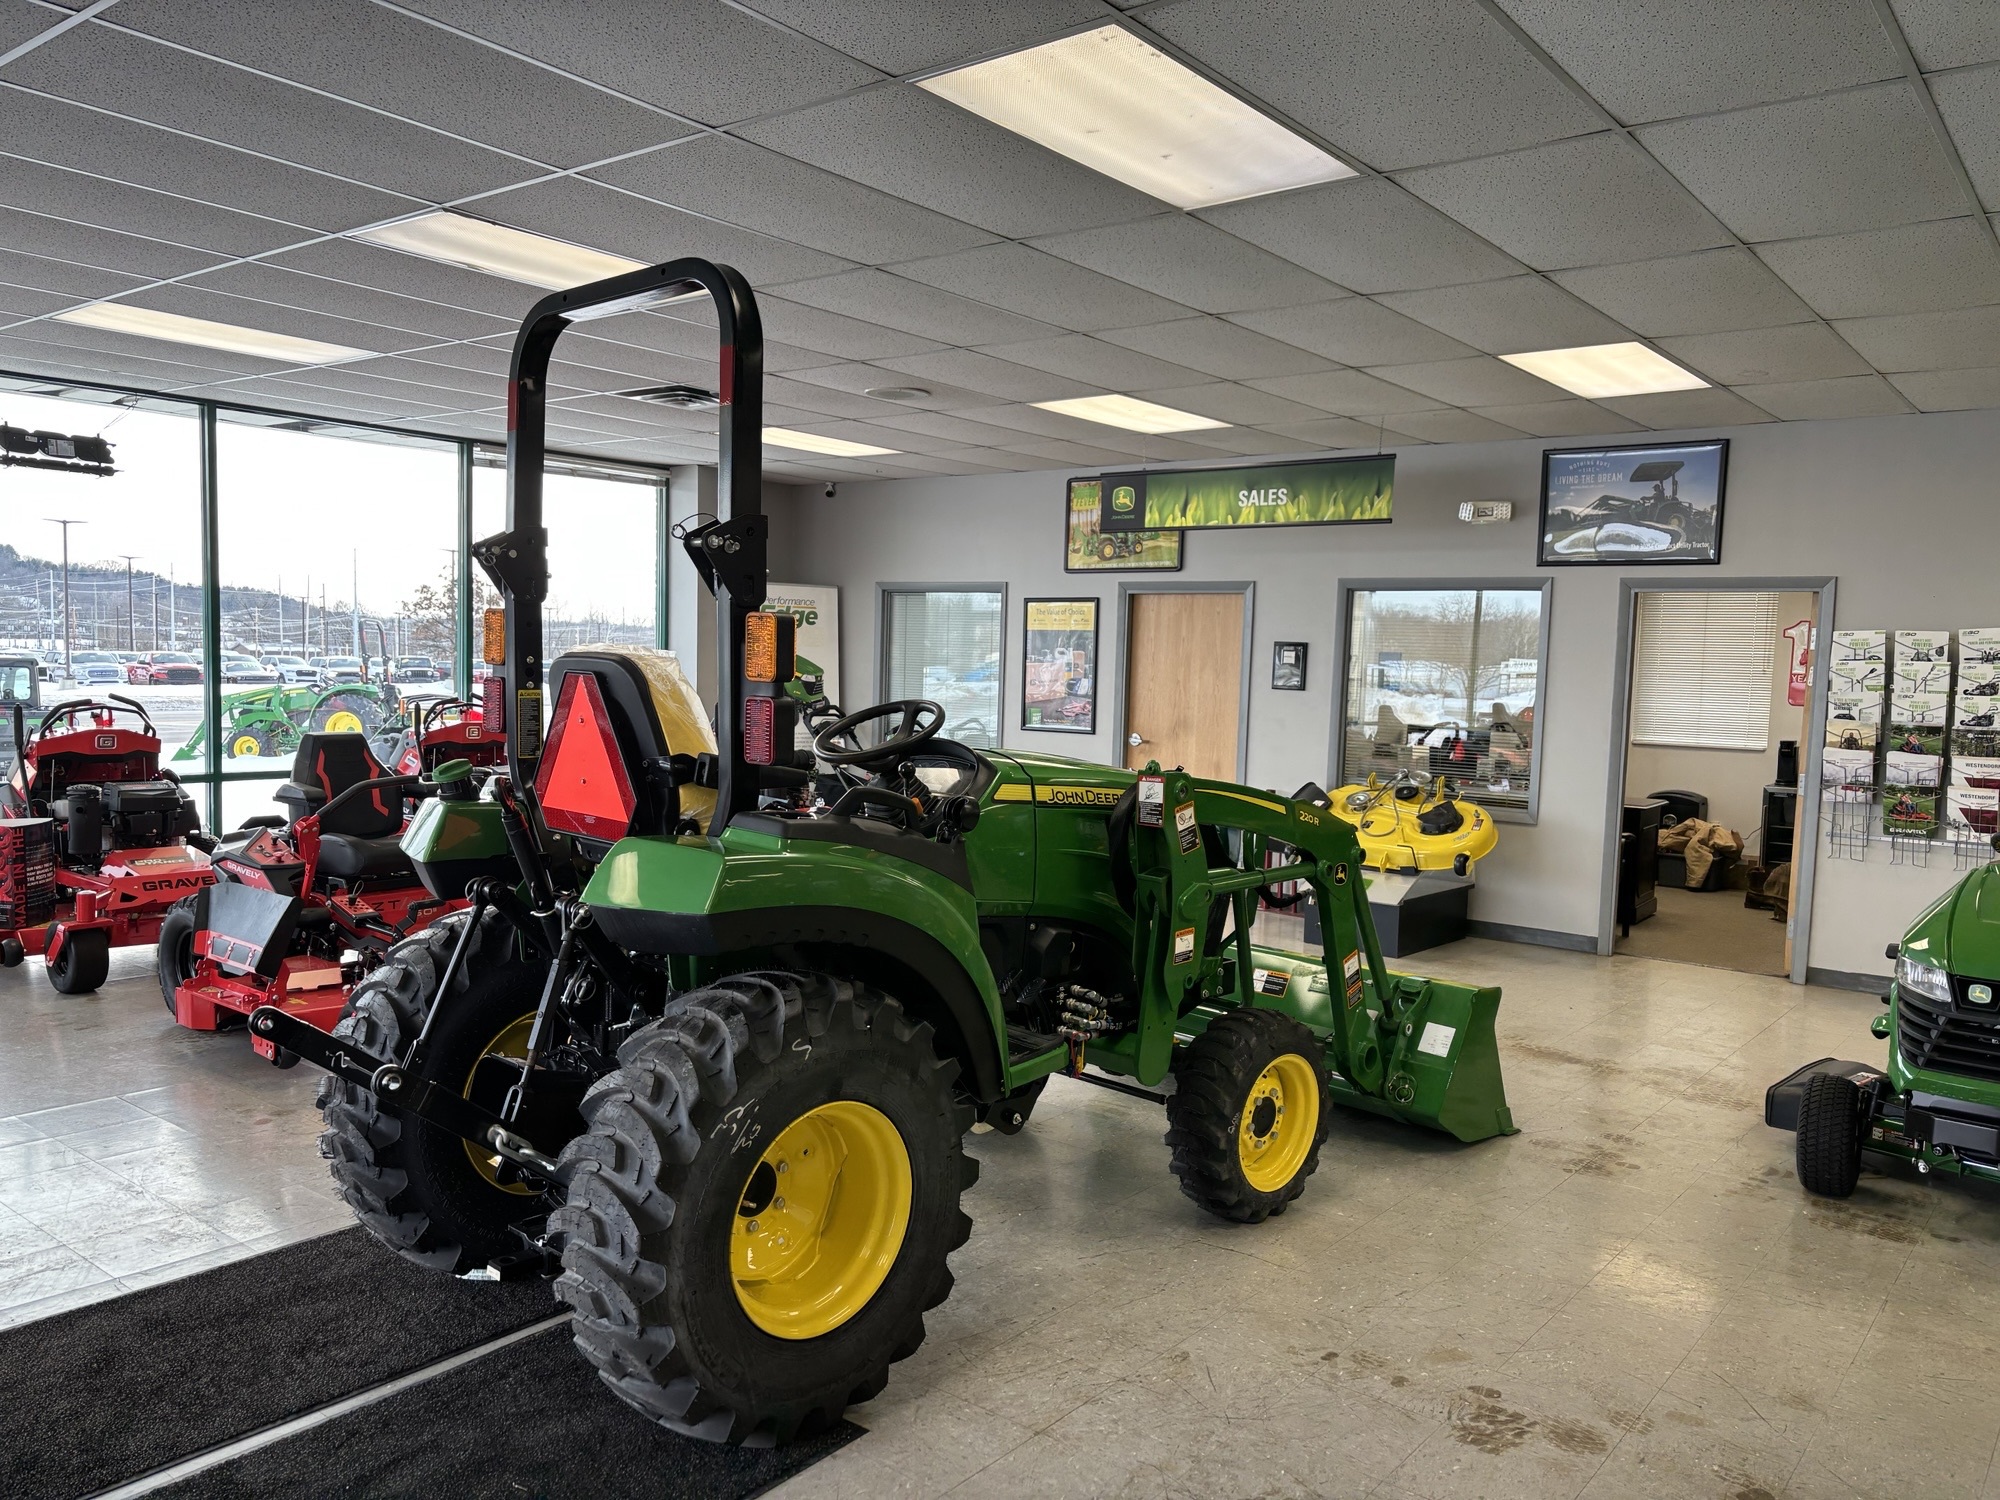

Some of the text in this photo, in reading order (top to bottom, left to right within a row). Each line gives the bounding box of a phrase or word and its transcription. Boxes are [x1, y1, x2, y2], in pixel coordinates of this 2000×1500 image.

[1555, 472, 1623, 485] LIVING THE DREAM
[1238, 488, 1288, 507] SALES
[1067, 608, 1085, 616] Choice
[1047, 788, 1122, 804] JOHN DEER
[12, 827, 27, 929] MADE IN THE
[227, 861, 261, 880] GRAVELY
[142, 875, 214, 892] GRAVE
